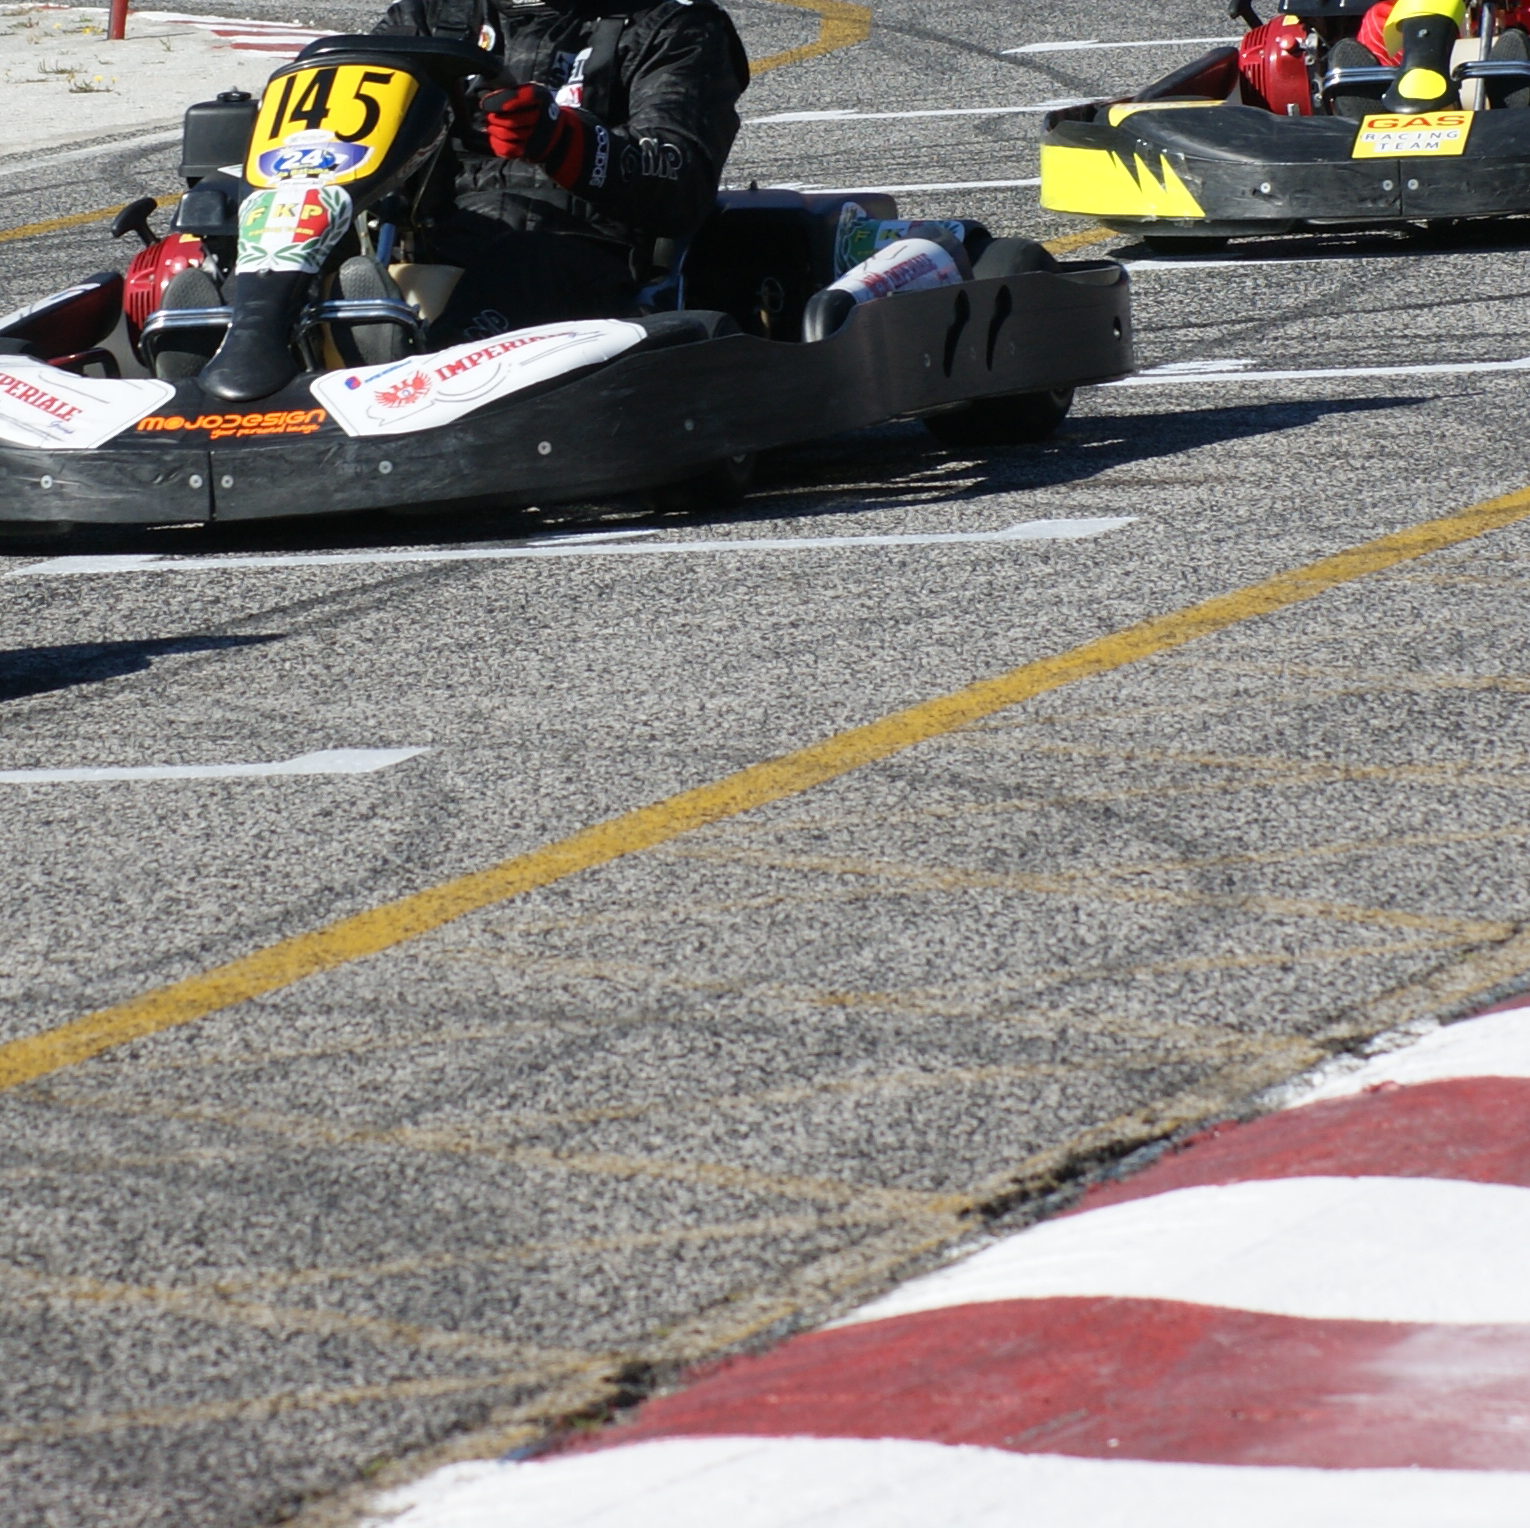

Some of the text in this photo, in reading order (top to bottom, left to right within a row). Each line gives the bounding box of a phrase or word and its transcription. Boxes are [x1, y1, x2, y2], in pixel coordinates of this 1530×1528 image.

[268, 67, 396, 144] 145
[1367, 115, 1465, 129] GAS
[1365, 131, 1458, 141] RACING
[1380, 142, 1439, 150] TEAM
[589, 125, 610, 189] sparco
